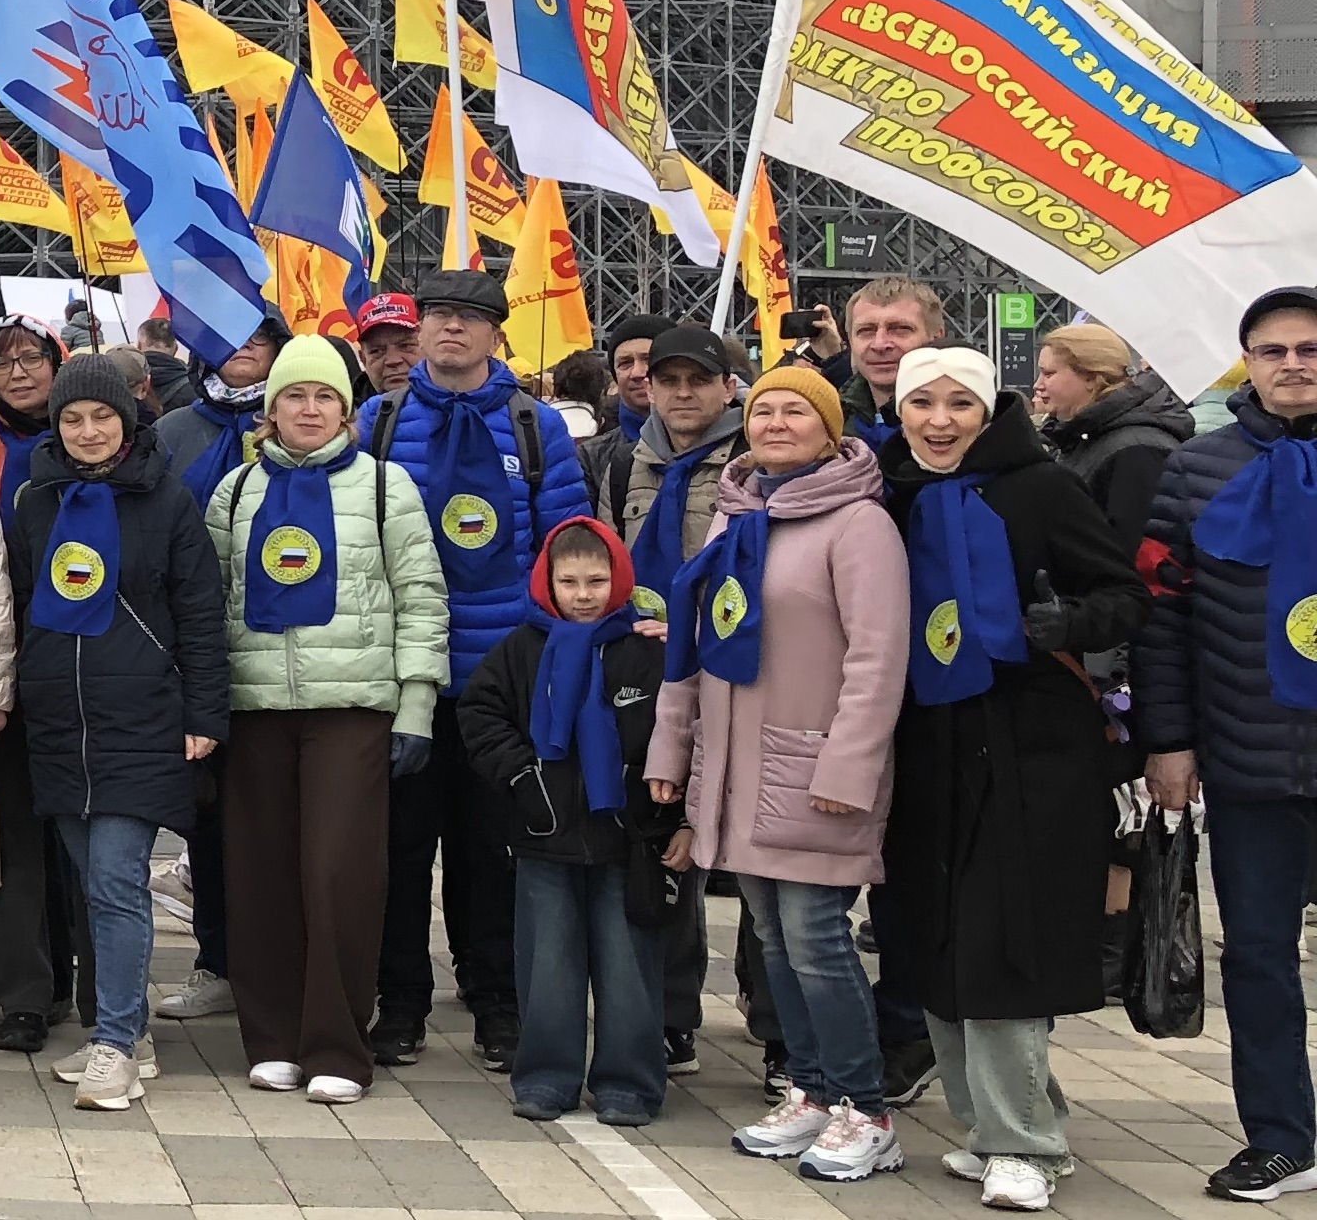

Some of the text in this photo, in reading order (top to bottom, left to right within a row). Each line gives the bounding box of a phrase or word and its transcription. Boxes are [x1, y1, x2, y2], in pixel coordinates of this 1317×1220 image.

[788, 30, 946, 118] ЭЛЕКТРО
[840, 2, 1173, 218] «ВСЕРОССИЙСКИЙ
[857, 116, 1122, 262] ПРОФСОЮЗ»
[867, 234, 877, 258] 7
[618, 686, 642, 698] NIKE
